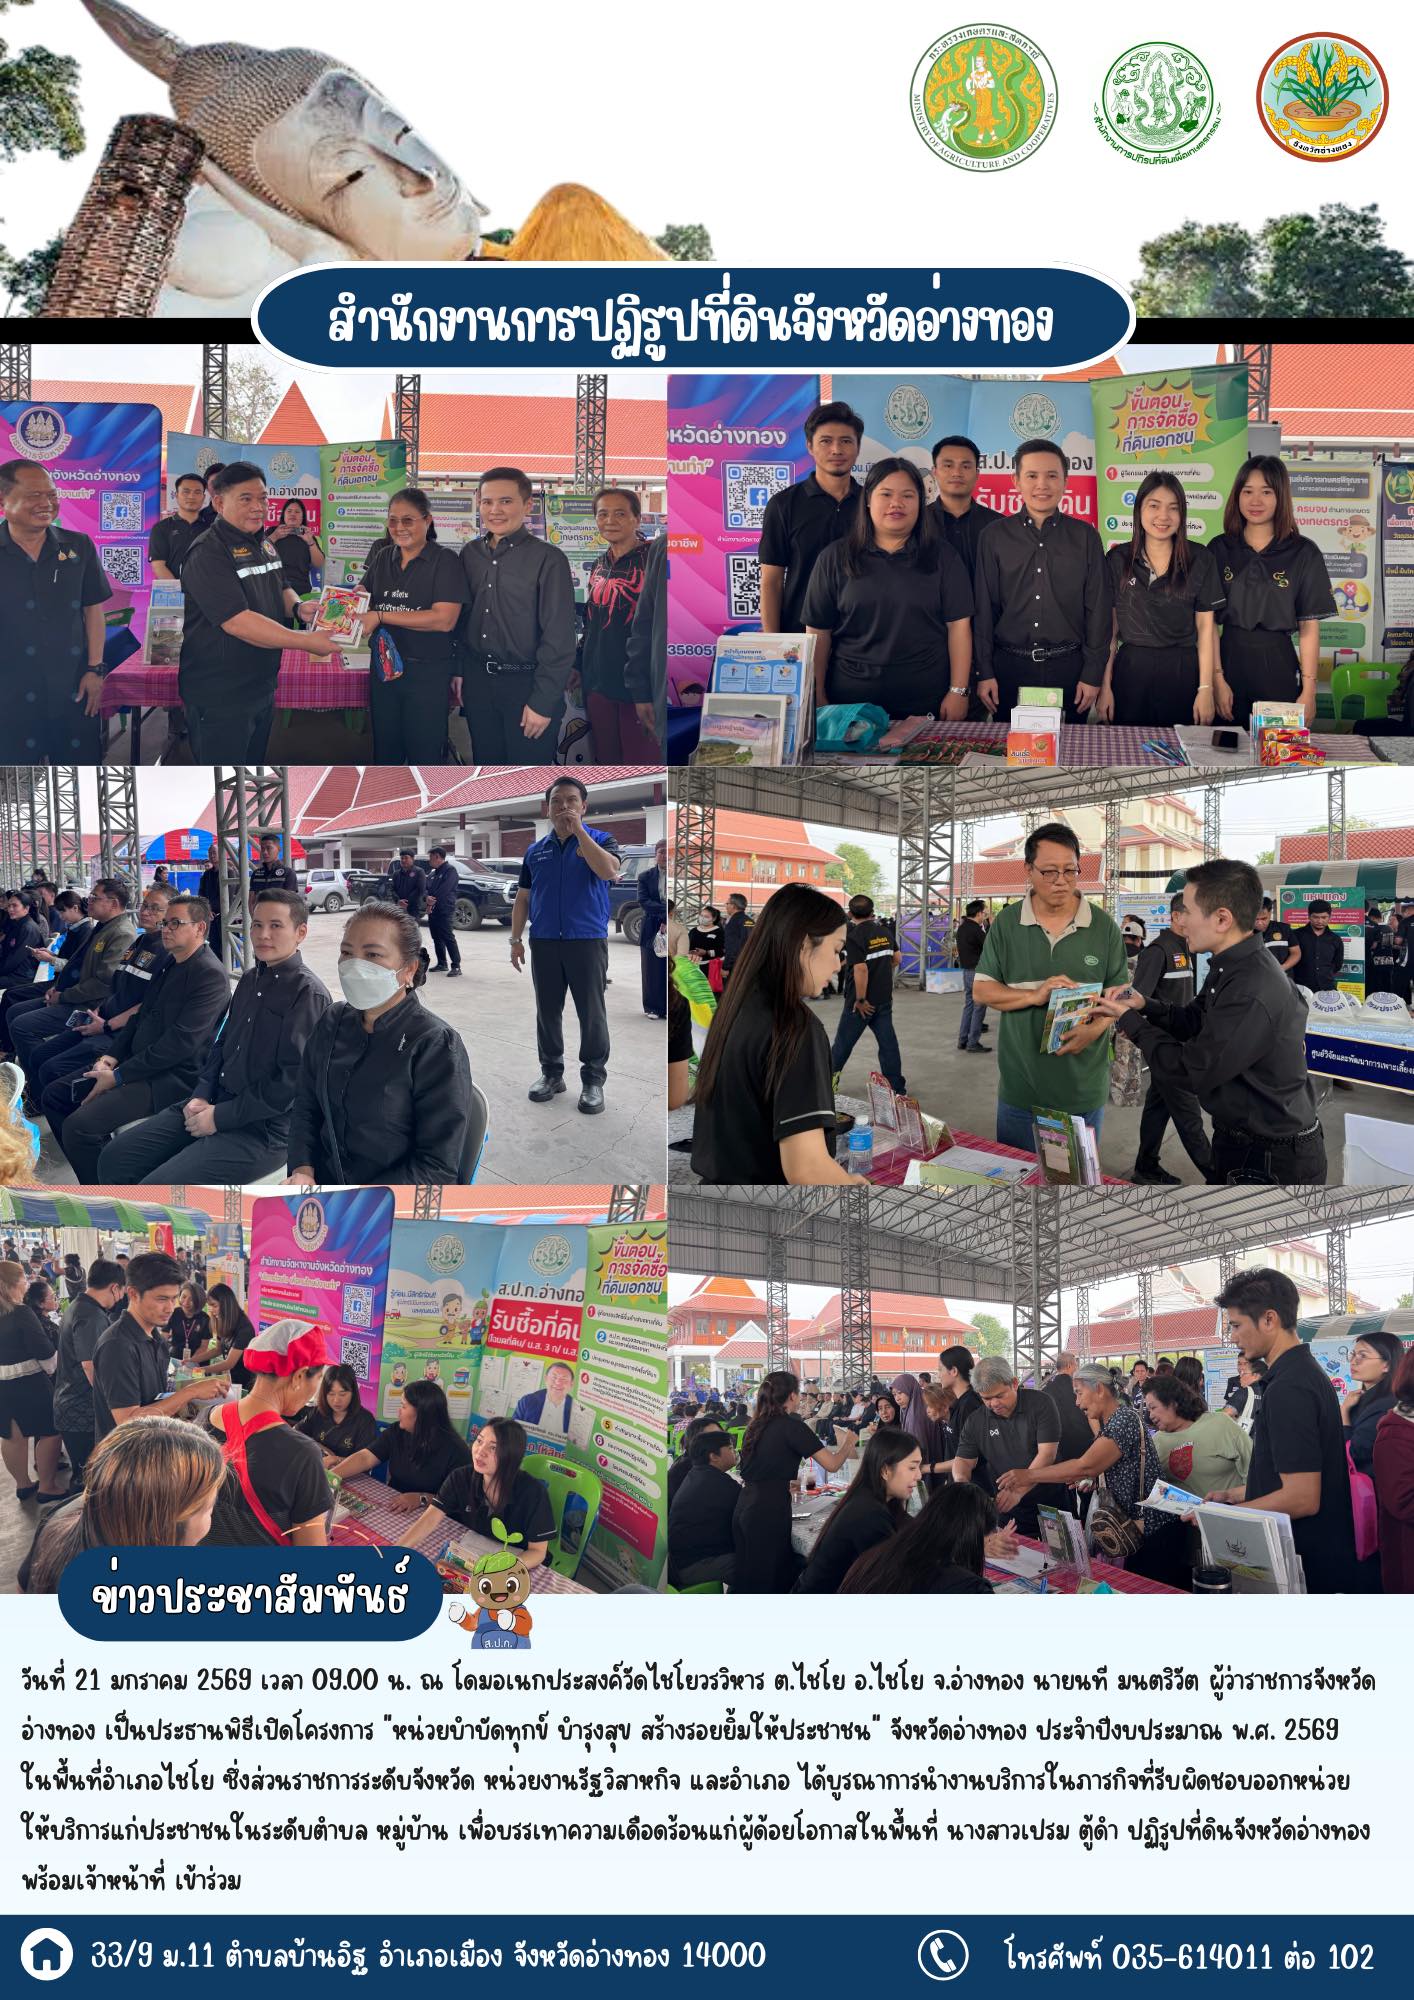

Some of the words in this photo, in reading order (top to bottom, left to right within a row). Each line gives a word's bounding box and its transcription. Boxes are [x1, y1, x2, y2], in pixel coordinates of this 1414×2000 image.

[1130, 387, 1183, 411] ขั้นตอน
[1127, 402, 1198, 429] การจัดซื้อ
[667, 424, 787, 445] หวัดอ่างทอง
[1122, 430, 1194, 452] ที่ดินเอกชน
[613, 1236, 658, 1259] ขั้นตอน
[608, 1253, 667, 1278] การจัดซื้อ
[602, 1275, 662, 1295] ที่ดินเอกชน
